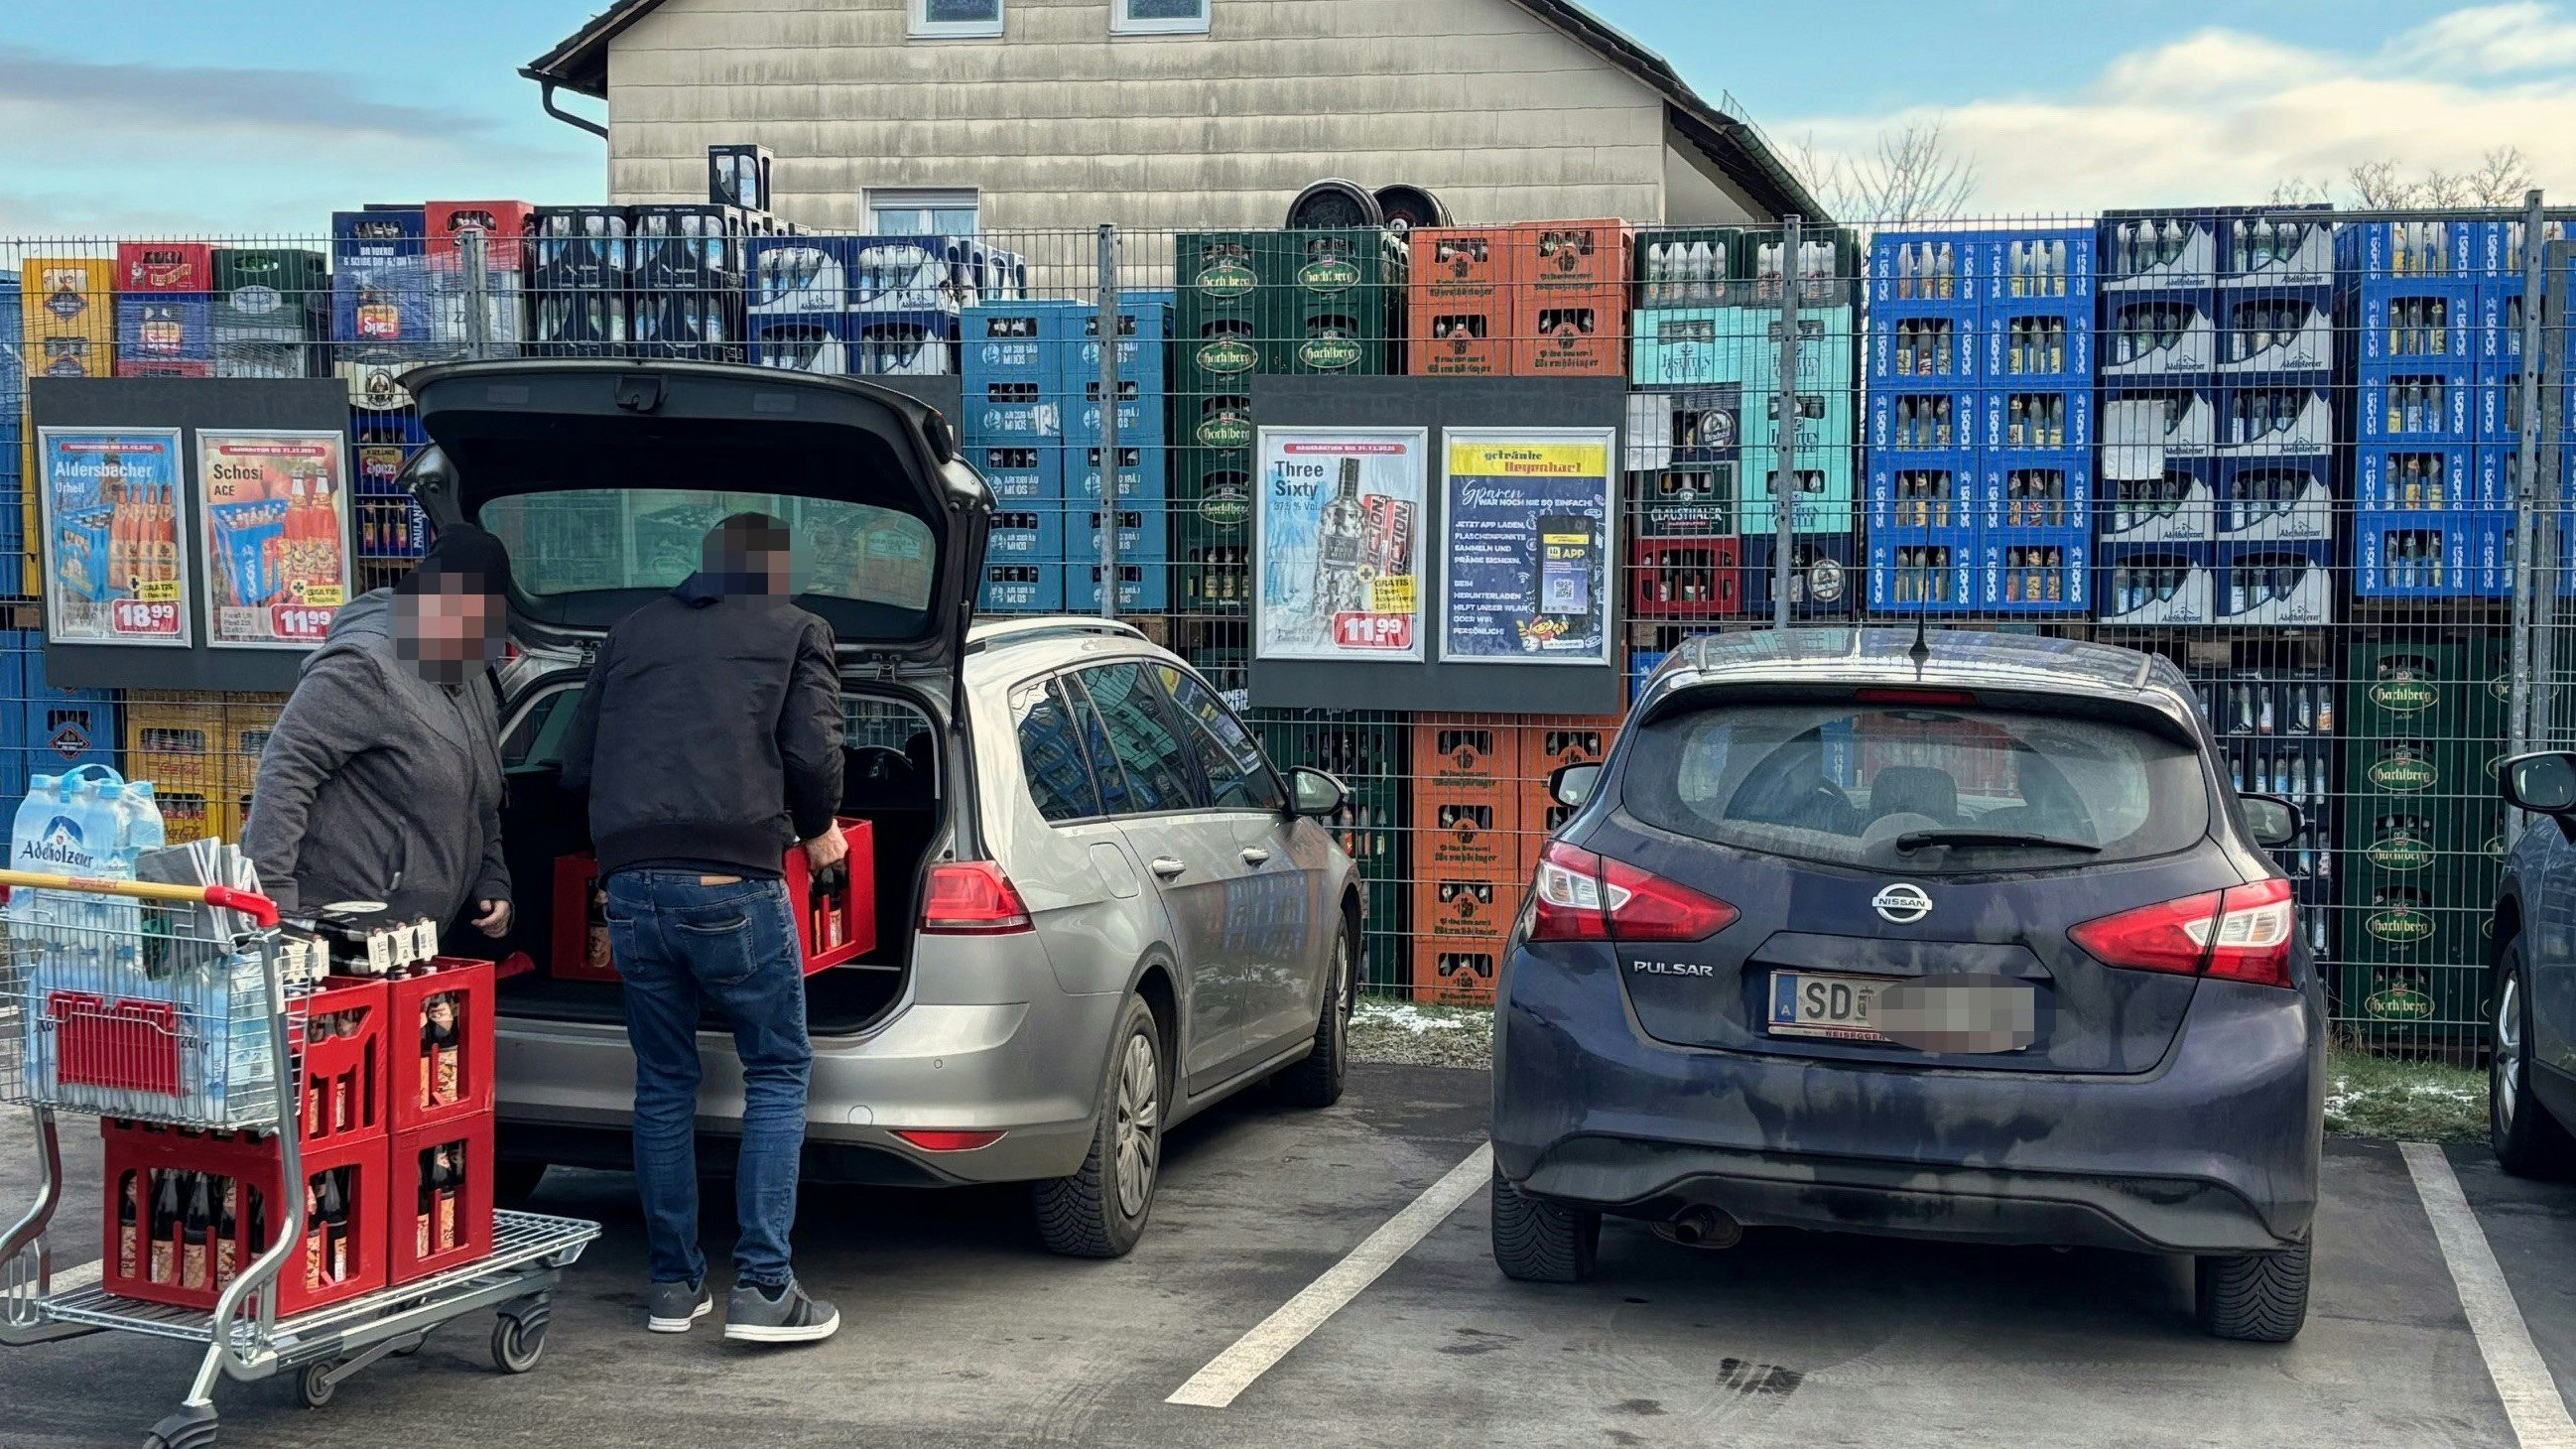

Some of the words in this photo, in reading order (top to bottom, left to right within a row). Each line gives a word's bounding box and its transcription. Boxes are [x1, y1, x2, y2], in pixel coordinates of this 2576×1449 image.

[55, 461, 152, 477] Aldersbacher
[212, 463, 263, 481] Schosi
[1274, 461, 1324, 476] Three
[56, 482, 85, 493] Urhell
[214, 485, 235, 496] ACE
[1275, 479, 1318, 501] Sixty
[1462, 479, 1524, 508] Sparen
[1651, 507, 1722, 522] CLAUSTHALER
[1562, 549, 1585, 559] APP
[119, 603, 175, 627] 18.99
[281, 610, 331, 633] 11.99
[1344, 617, 1402, 642] 11.99
[1877, 897, 1926, 907] NISSAN
[1633, 960, 1714, 978] PULSAR
[1805, 982, 1852, 1020] SD
[1780, 1004, 1791, 1016] A
